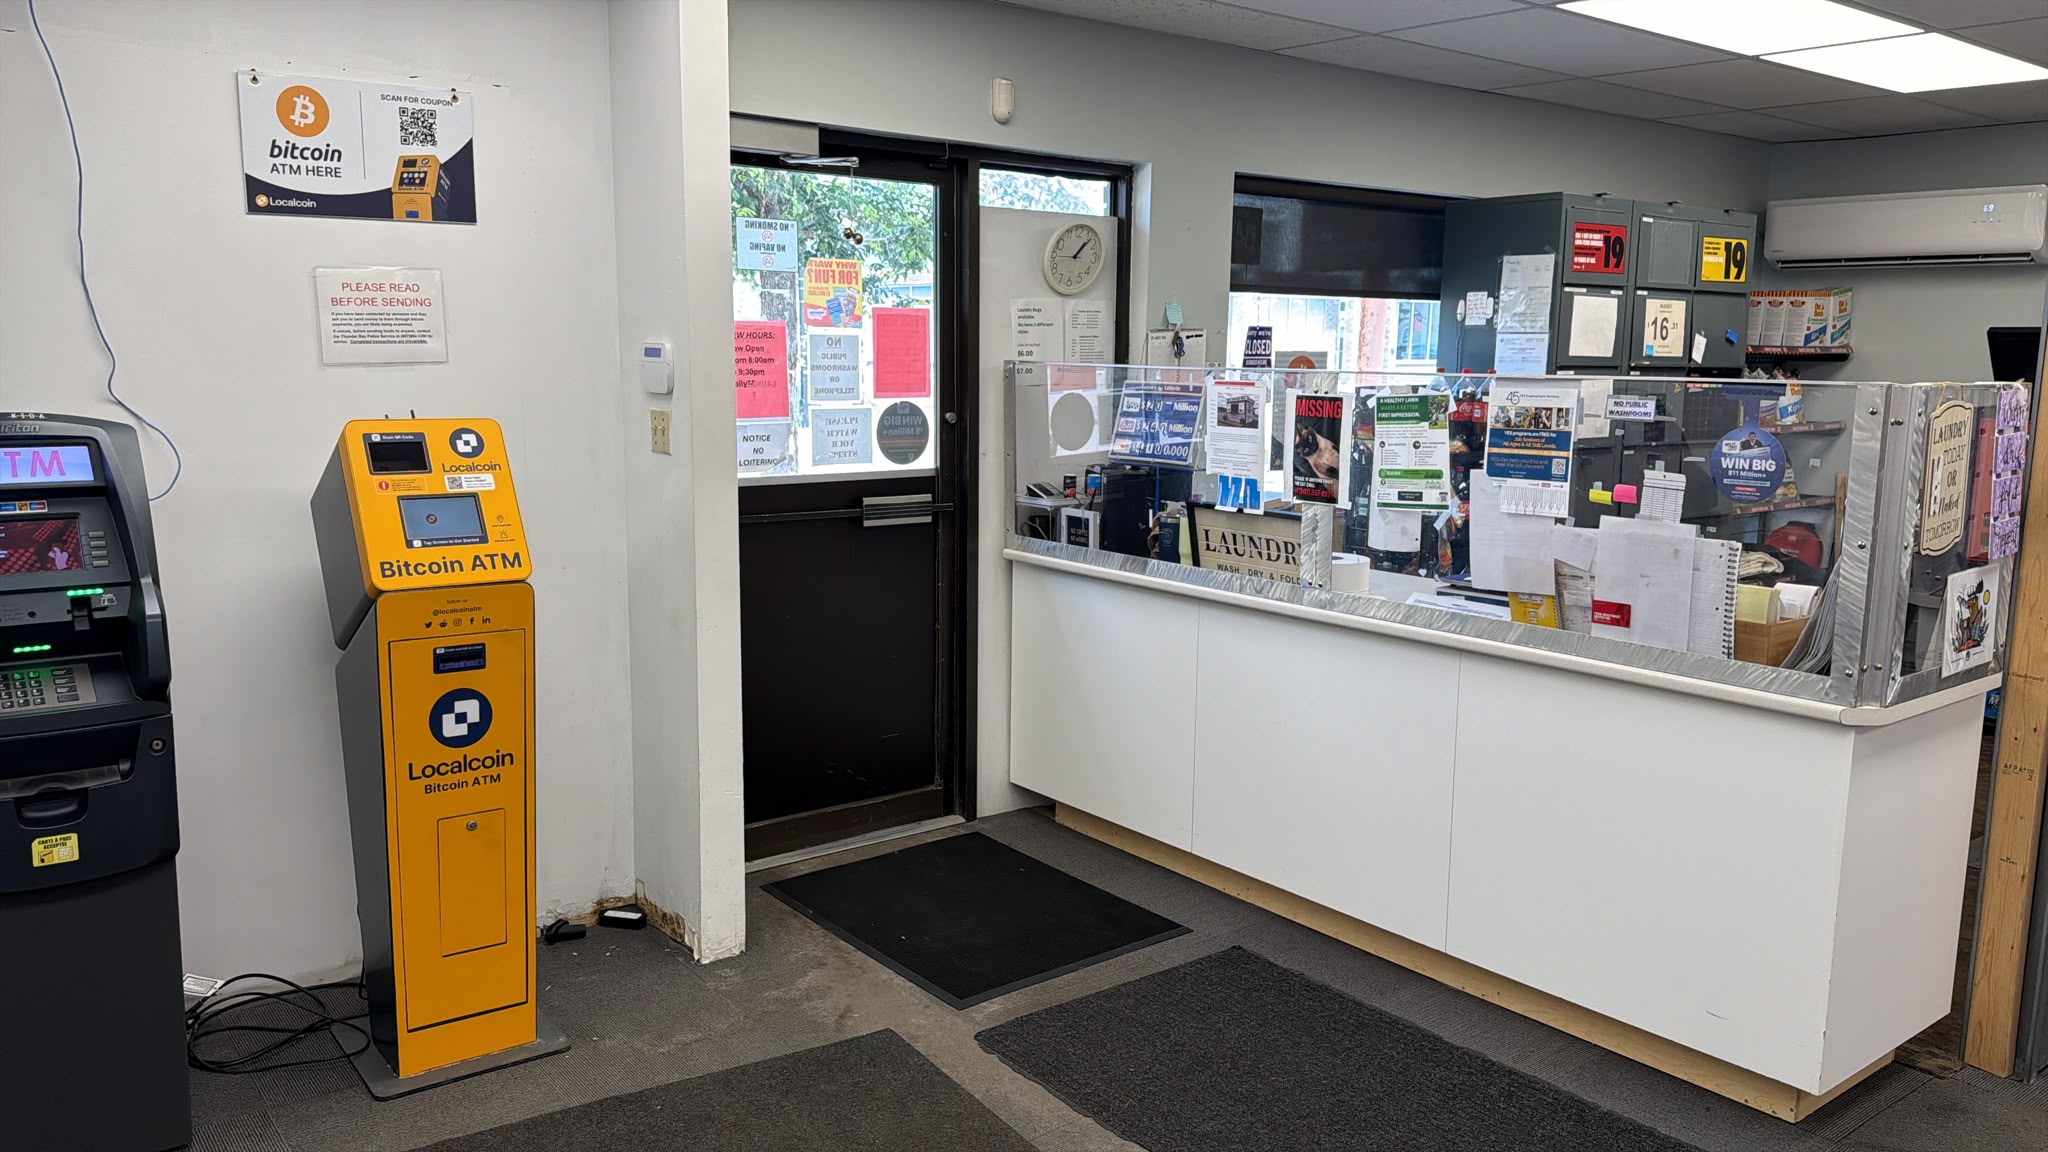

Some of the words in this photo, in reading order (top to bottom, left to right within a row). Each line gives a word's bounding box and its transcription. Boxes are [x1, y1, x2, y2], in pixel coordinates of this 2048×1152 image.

[380, 94, 402, 103] SCAN
[404, 96, 419, 104] FOR
[420, 97, 453, 107] COUPON
[269, 139, 342, 162] bitcoin
[270, 163, 302, 176] ATM
[306, 165, 342, 178] HERE
[270, 197, 316, 208] Localcoin
[1983, 203, 1994, 212] 69
[1075, 227, 1083, 238] 12
[1090, 239, 1096, 250] 2
[1090, 252, 1097, 264] 3
[1604, 236, 1624, 268] 19
[1724, 241, 1746, 280] 19
[1085, 266, 1090, 275] 4
[1059, 273, 1064, 283] 7
[1066, 276, 1072, 287] 6
[1077, 273, 1083, 283] 5
[342, 283, 386, 292] PLEASE
[389, 283, 420, 292] READ
[331, 297, 378, 306] BEFORE
[382, 298, 432, 307] SENDING
[1246, 340, 1271, 355] CLOSED
[1506, 391, 1520, 405] 45
[1173, 403, 1198, 413] Million
[1296, 399, 1342, 419] MISSING
[1169, 424, 1193, 433] Million
[1933, 416, 1969, 445] LAUNDRY
[1943, 444, 1966, 466] TODAY
[442, 462, 502, 472] Localcoin
[1721, 457, 1749, 470] WIN
[1752, 459, 1776, 472] BIG
[1947, 470, 1957, 487] OR
[1925, 517, 1960, 543] TOMORROW
[1203, 528, 1301, 567] LAUNDR
[380, 556, 463, 578] Bitcoin
[472, 552, 522, 571] ATM
[1248, 568, 1264, 578] DRY
[432, 606, 482, 616] @localcoinatm
[408, 749, 514, 780] Localcoin
[424, 779, 468, 794] Bitcoin
[472, 773, 501, 786] ATM
